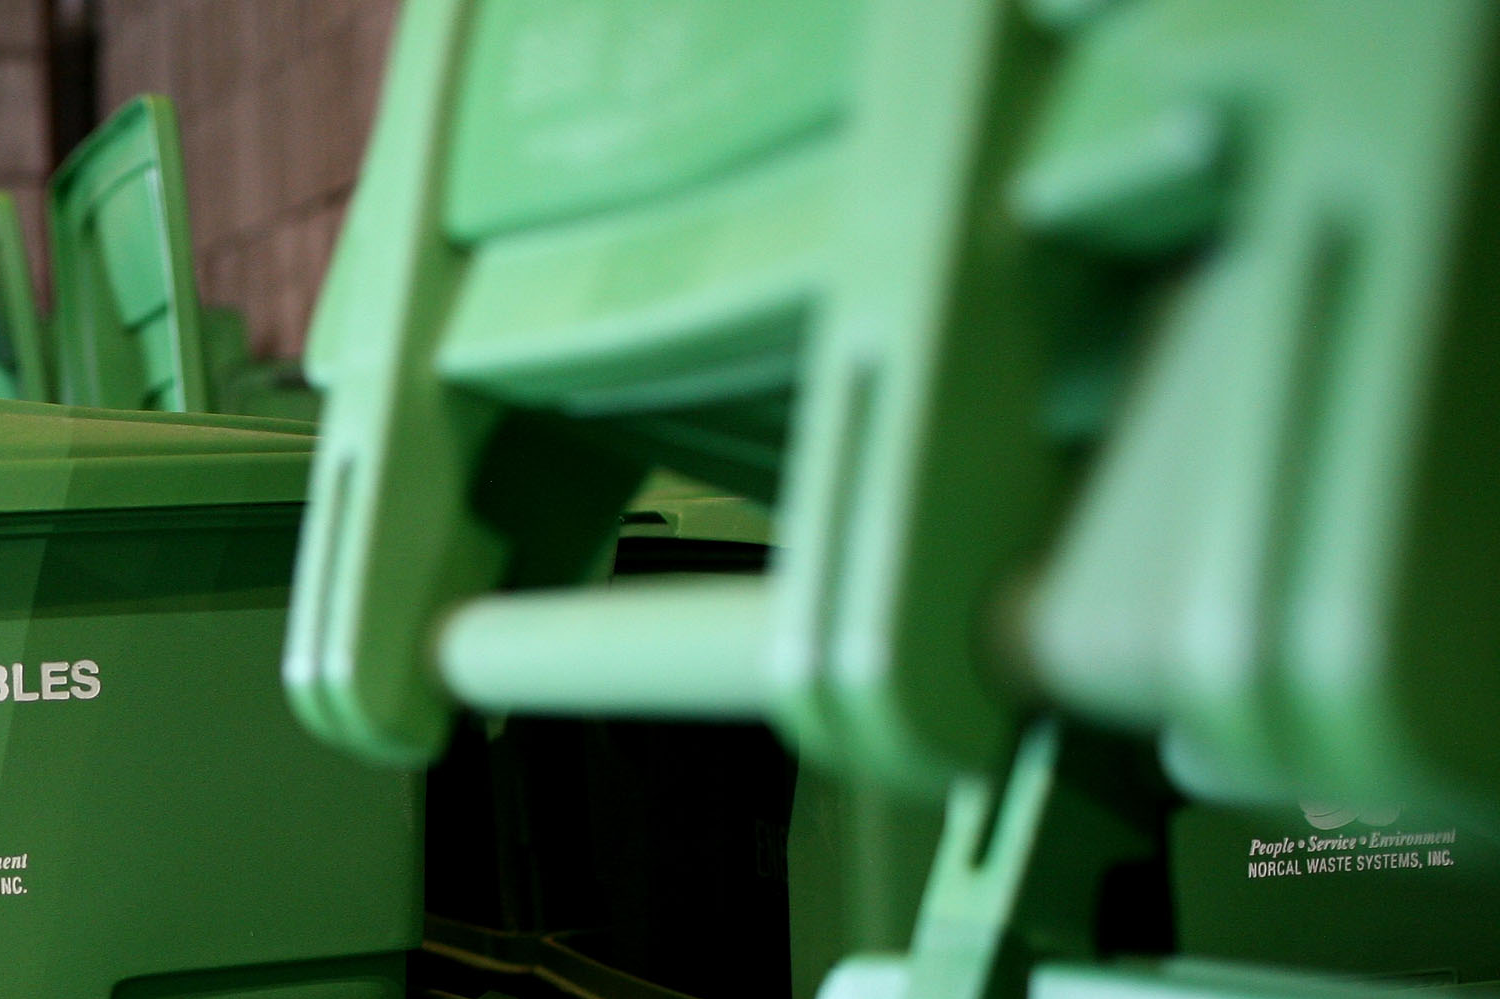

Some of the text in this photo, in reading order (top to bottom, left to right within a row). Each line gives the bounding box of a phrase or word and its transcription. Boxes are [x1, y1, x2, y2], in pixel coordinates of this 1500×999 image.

[1248, 828, 1456, 859] People Service Environment
[1248, 849, 1456, 879] NORCAL WASTE SYSTEMS, INC.
